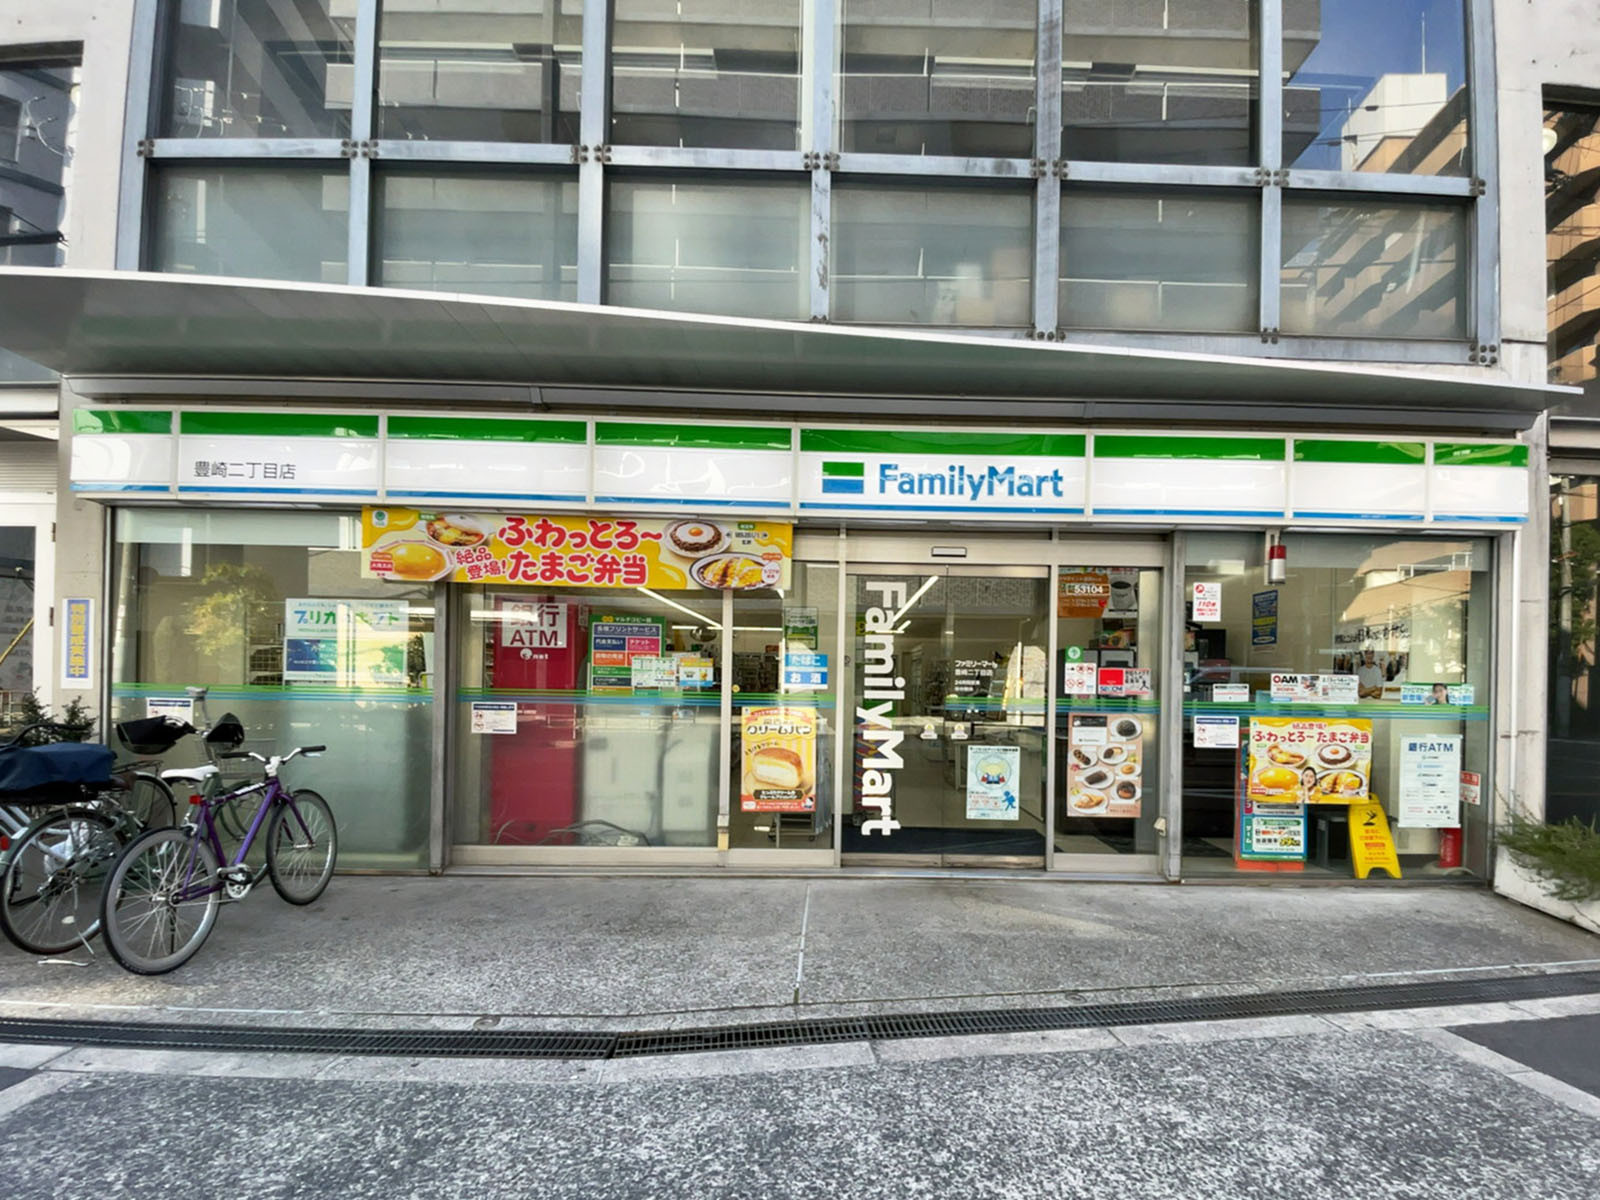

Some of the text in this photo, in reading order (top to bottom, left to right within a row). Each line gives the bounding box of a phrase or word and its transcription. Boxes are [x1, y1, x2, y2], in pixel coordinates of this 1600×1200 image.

[194, 461, 296, 479] 豊崎二丁目店
[879, 464, 1064, 501] FamilyMart
[508, 550, 646, 585] たまご弁当
[510, 629, 558, 646] ATM
[856, 581, 908, 837] FamilyMart
[1317, 731, 1369, 743] たまご弁当
